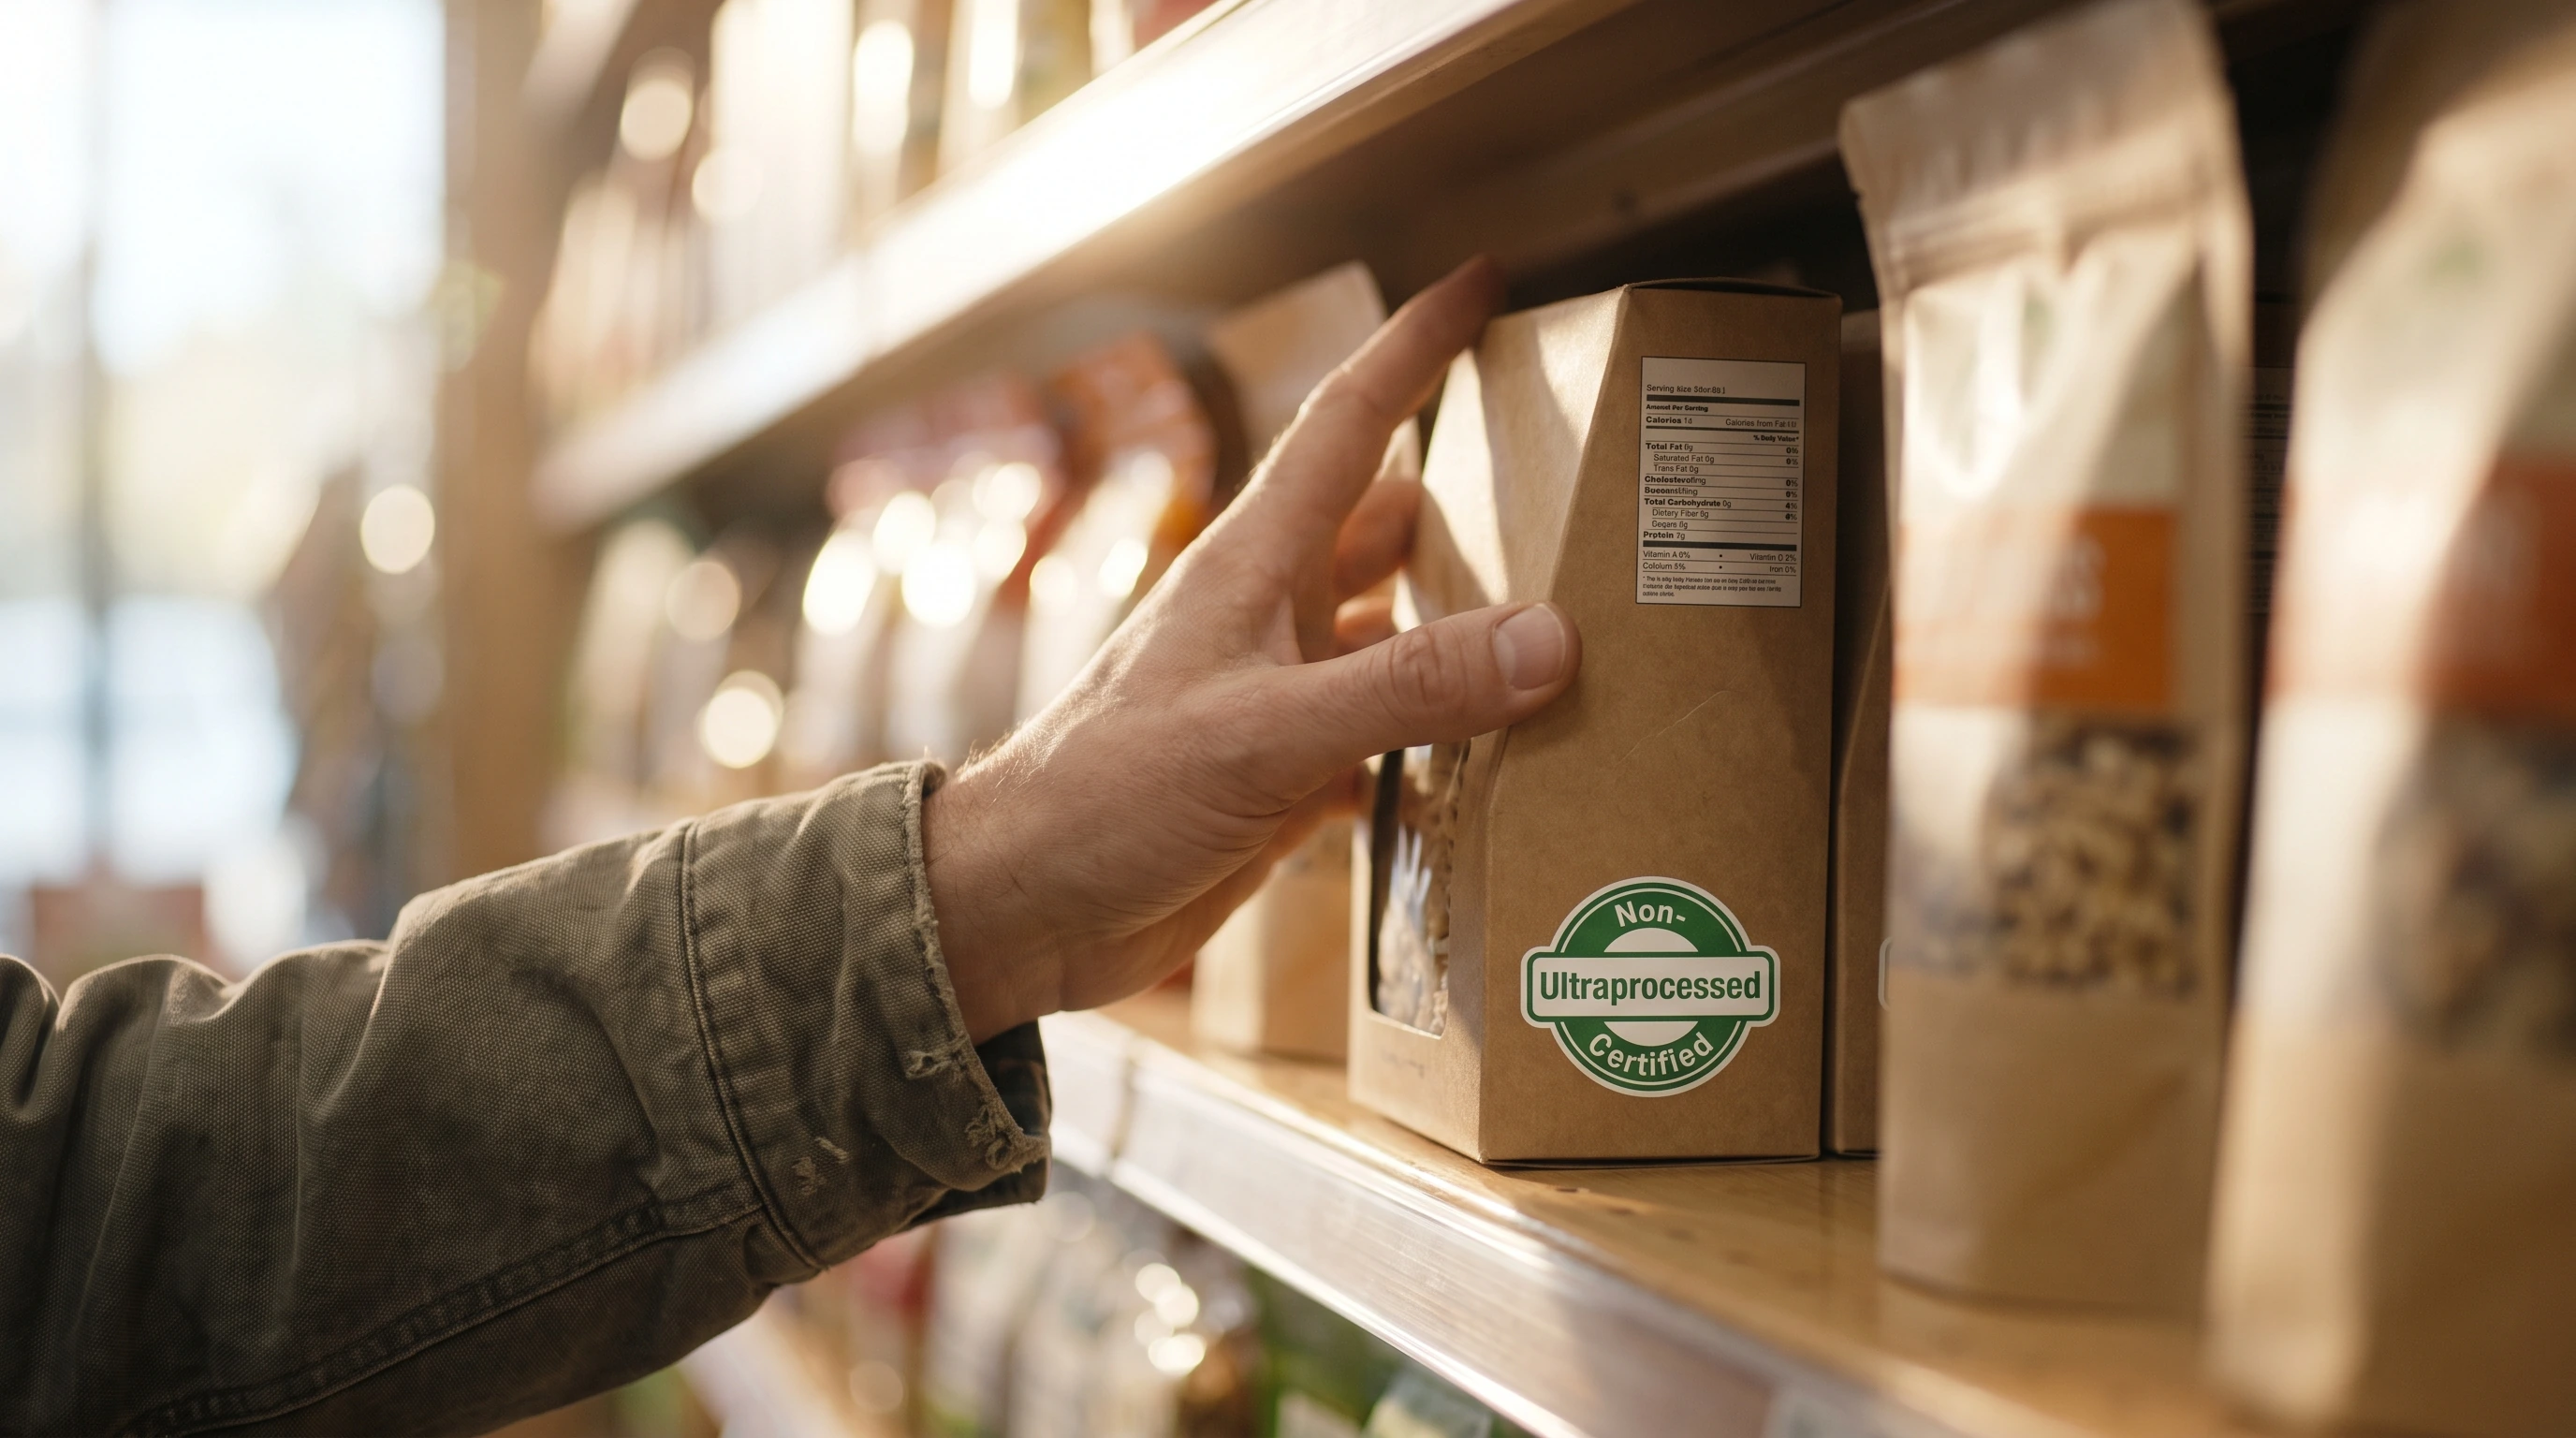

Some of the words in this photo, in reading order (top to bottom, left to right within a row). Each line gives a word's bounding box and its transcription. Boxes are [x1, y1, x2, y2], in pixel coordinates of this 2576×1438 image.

[1647, 385, 1674, 393] Serving
[1690, 465, 1699, 474] 0g
[1614, 901, 1686, 927] Non-
[1541, 971, 1760, 1005] Ultraprocessed
[1589, 1032, 1714, 1077] Certified
